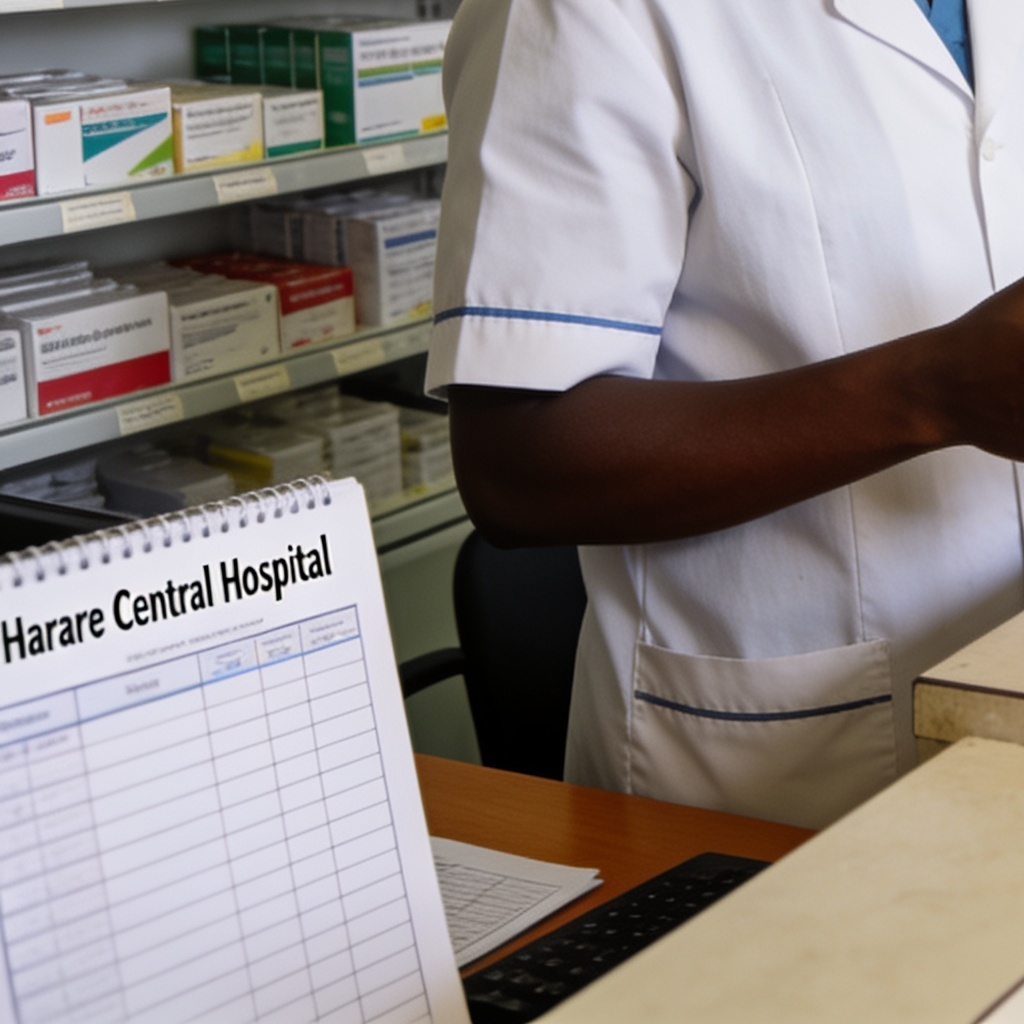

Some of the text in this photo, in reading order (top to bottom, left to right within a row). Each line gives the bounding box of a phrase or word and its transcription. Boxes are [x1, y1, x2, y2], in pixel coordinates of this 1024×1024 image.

[1, 607, 106, 664] Harare
[112, 564, 214, 631] Central
[219, 533, 333, 603] Hospital
